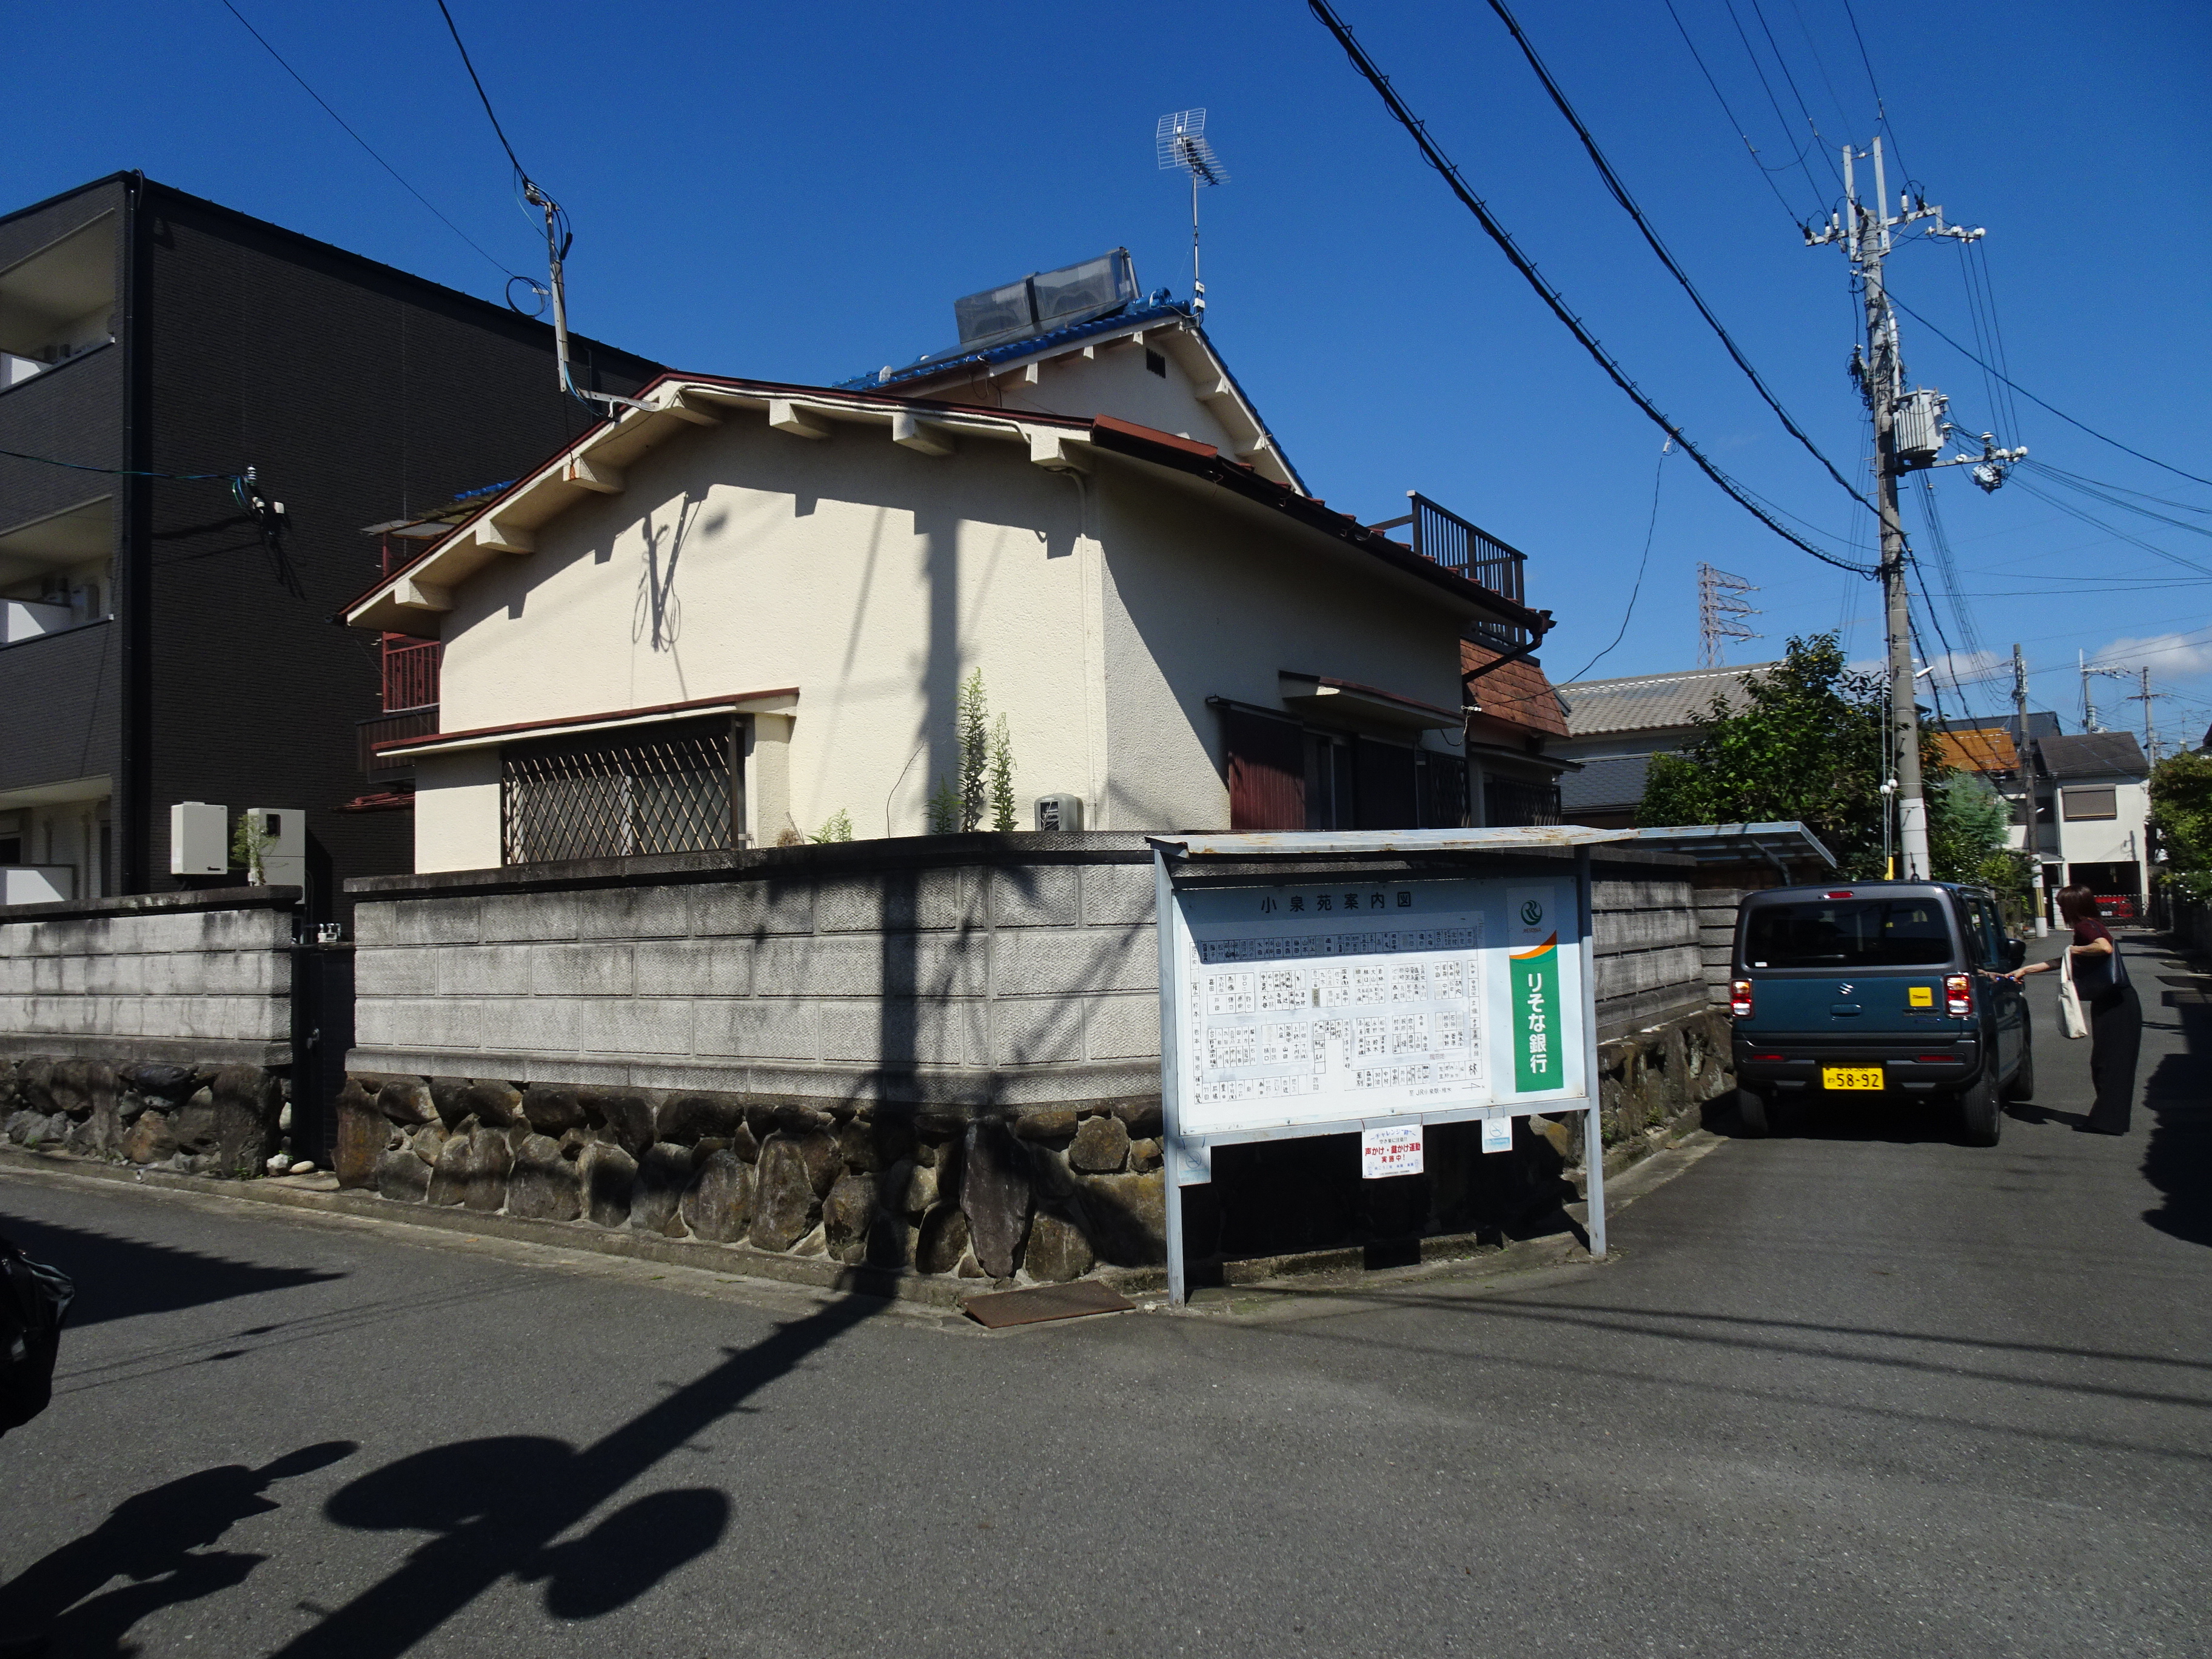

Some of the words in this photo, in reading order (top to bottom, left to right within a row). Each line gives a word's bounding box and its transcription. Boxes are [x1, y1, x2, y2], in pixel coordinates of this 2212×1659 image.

[1261, 891, 1411, 913] 小泉苑案内図
[1527, 973, 1547, 1074] りそな銀行
[1282, 1046, 1289, 1059] 山田
[1836, 1073, 1880, 1087] 58-92
